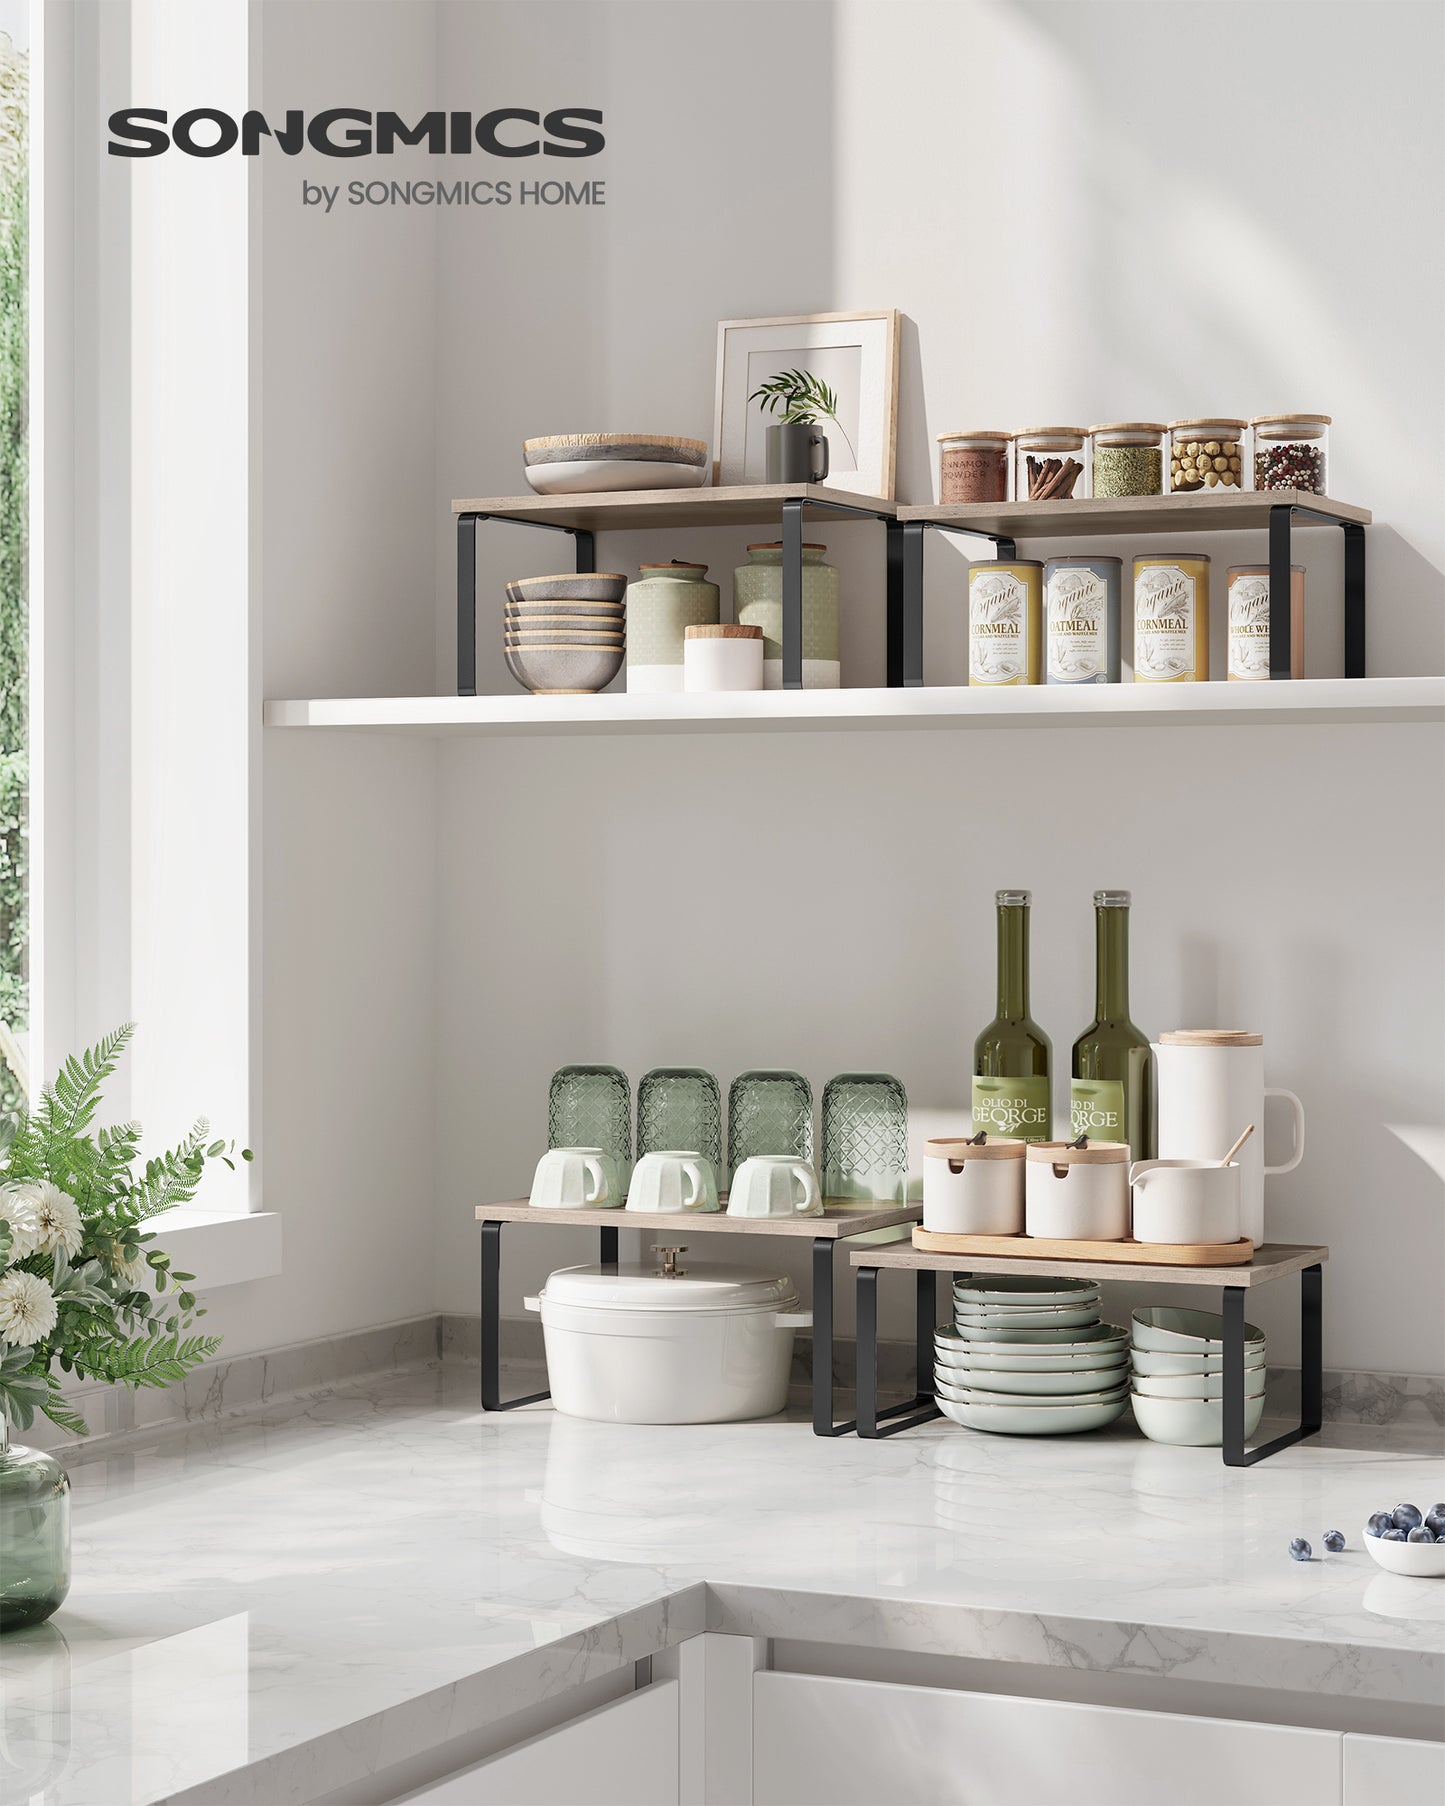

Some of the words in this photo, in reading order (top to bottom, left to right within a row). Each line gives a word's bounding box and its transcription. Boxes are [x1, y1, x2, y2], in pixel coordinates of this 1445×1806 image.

[942, 460, 990, 470] CINNAMON
[943, 471, 986, 480] POWDER
[972, 583, 1018, 621] rganic
[1049, 580, 1097, 617] rganic
[971, 623, 1021, 635] CORNMEAL
[1049, 620, 1099, 632] OATMEAL
[1137, 618, 1188, 630] CORNMEAL
[982, 1098, 1012, 1108] OLIO
[1014, 1099, 1027, 1108] DI
[1083, 1101, 1096, 1111] DI
[972, 1106, 1047, 1124] GEORGE
[1071, 1109, 1119, 1128] ORGE
